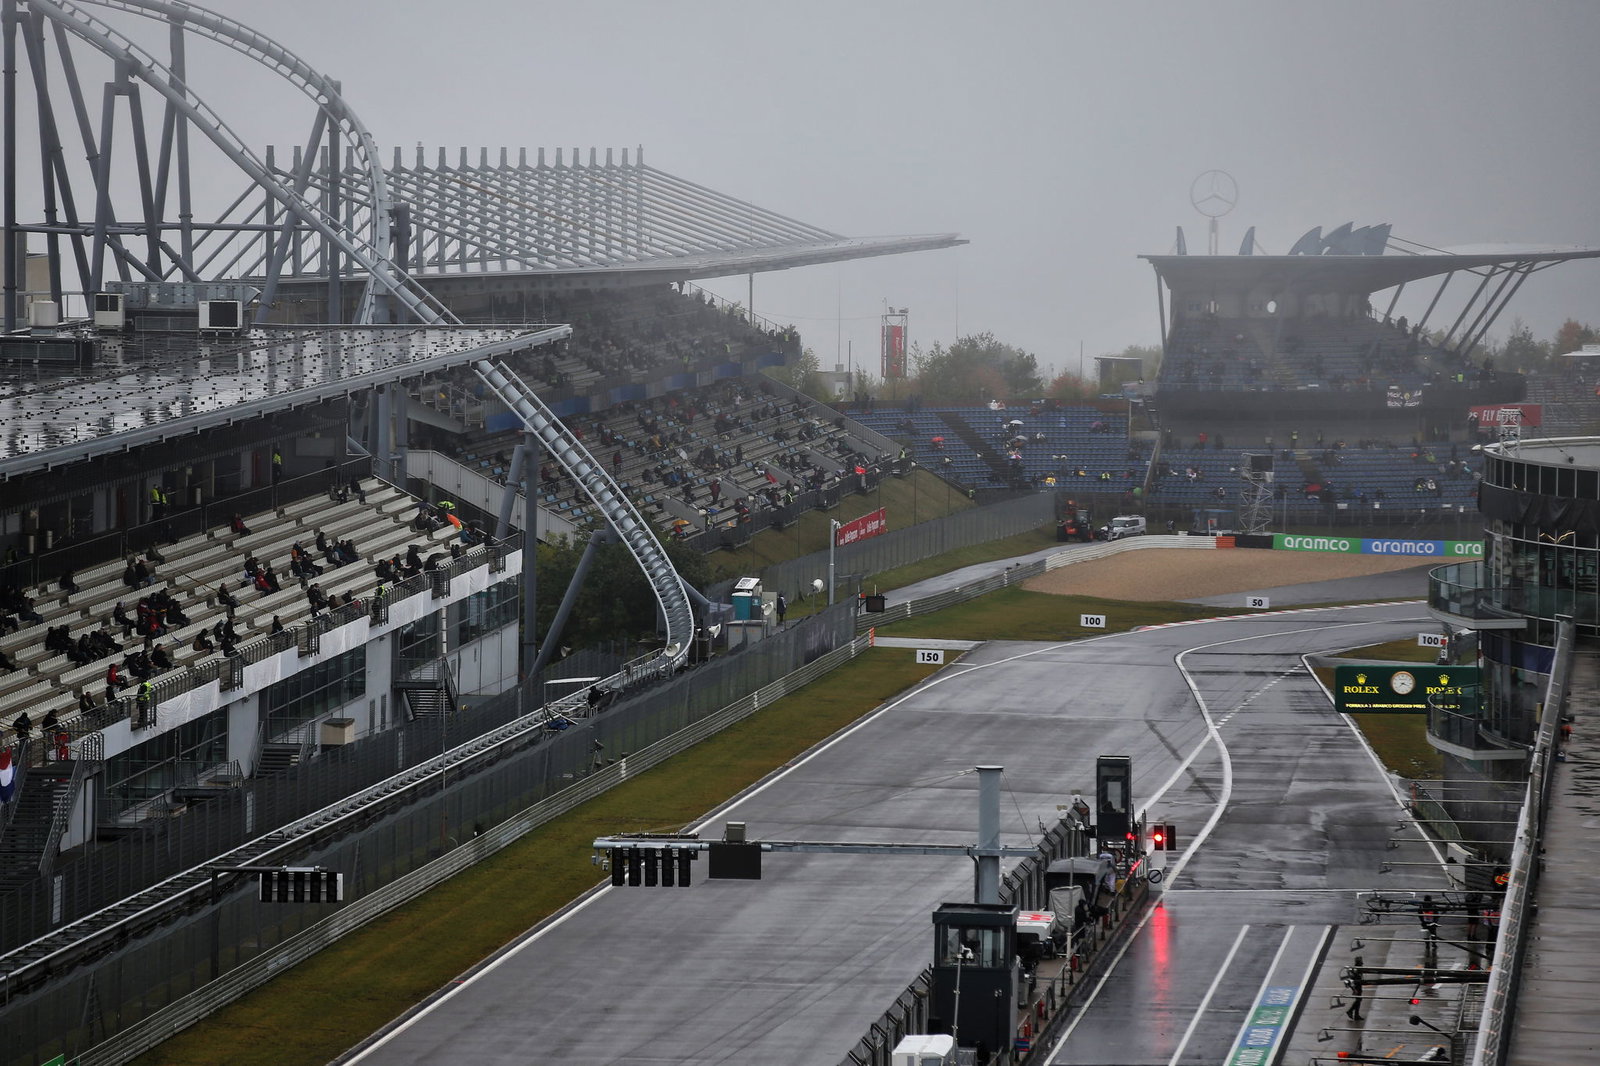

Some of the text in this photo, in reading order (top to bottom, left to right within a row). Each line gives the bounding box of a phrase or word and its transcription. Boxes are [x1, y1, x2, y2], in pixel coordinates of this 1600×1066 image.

[1482, 410, 1496, 421] FLY
[1284, 536, 1350, 551] aramco
[1371, 541, 1435, 553] aramco
[1454, 543, 1482, 554] ara
[1085, 616, 1101, 625] 100
[1422, 635, 1439, 645] 100
[921, 652, 939, 662] 150
[1343, 686, 1379, 694] ROLEX
